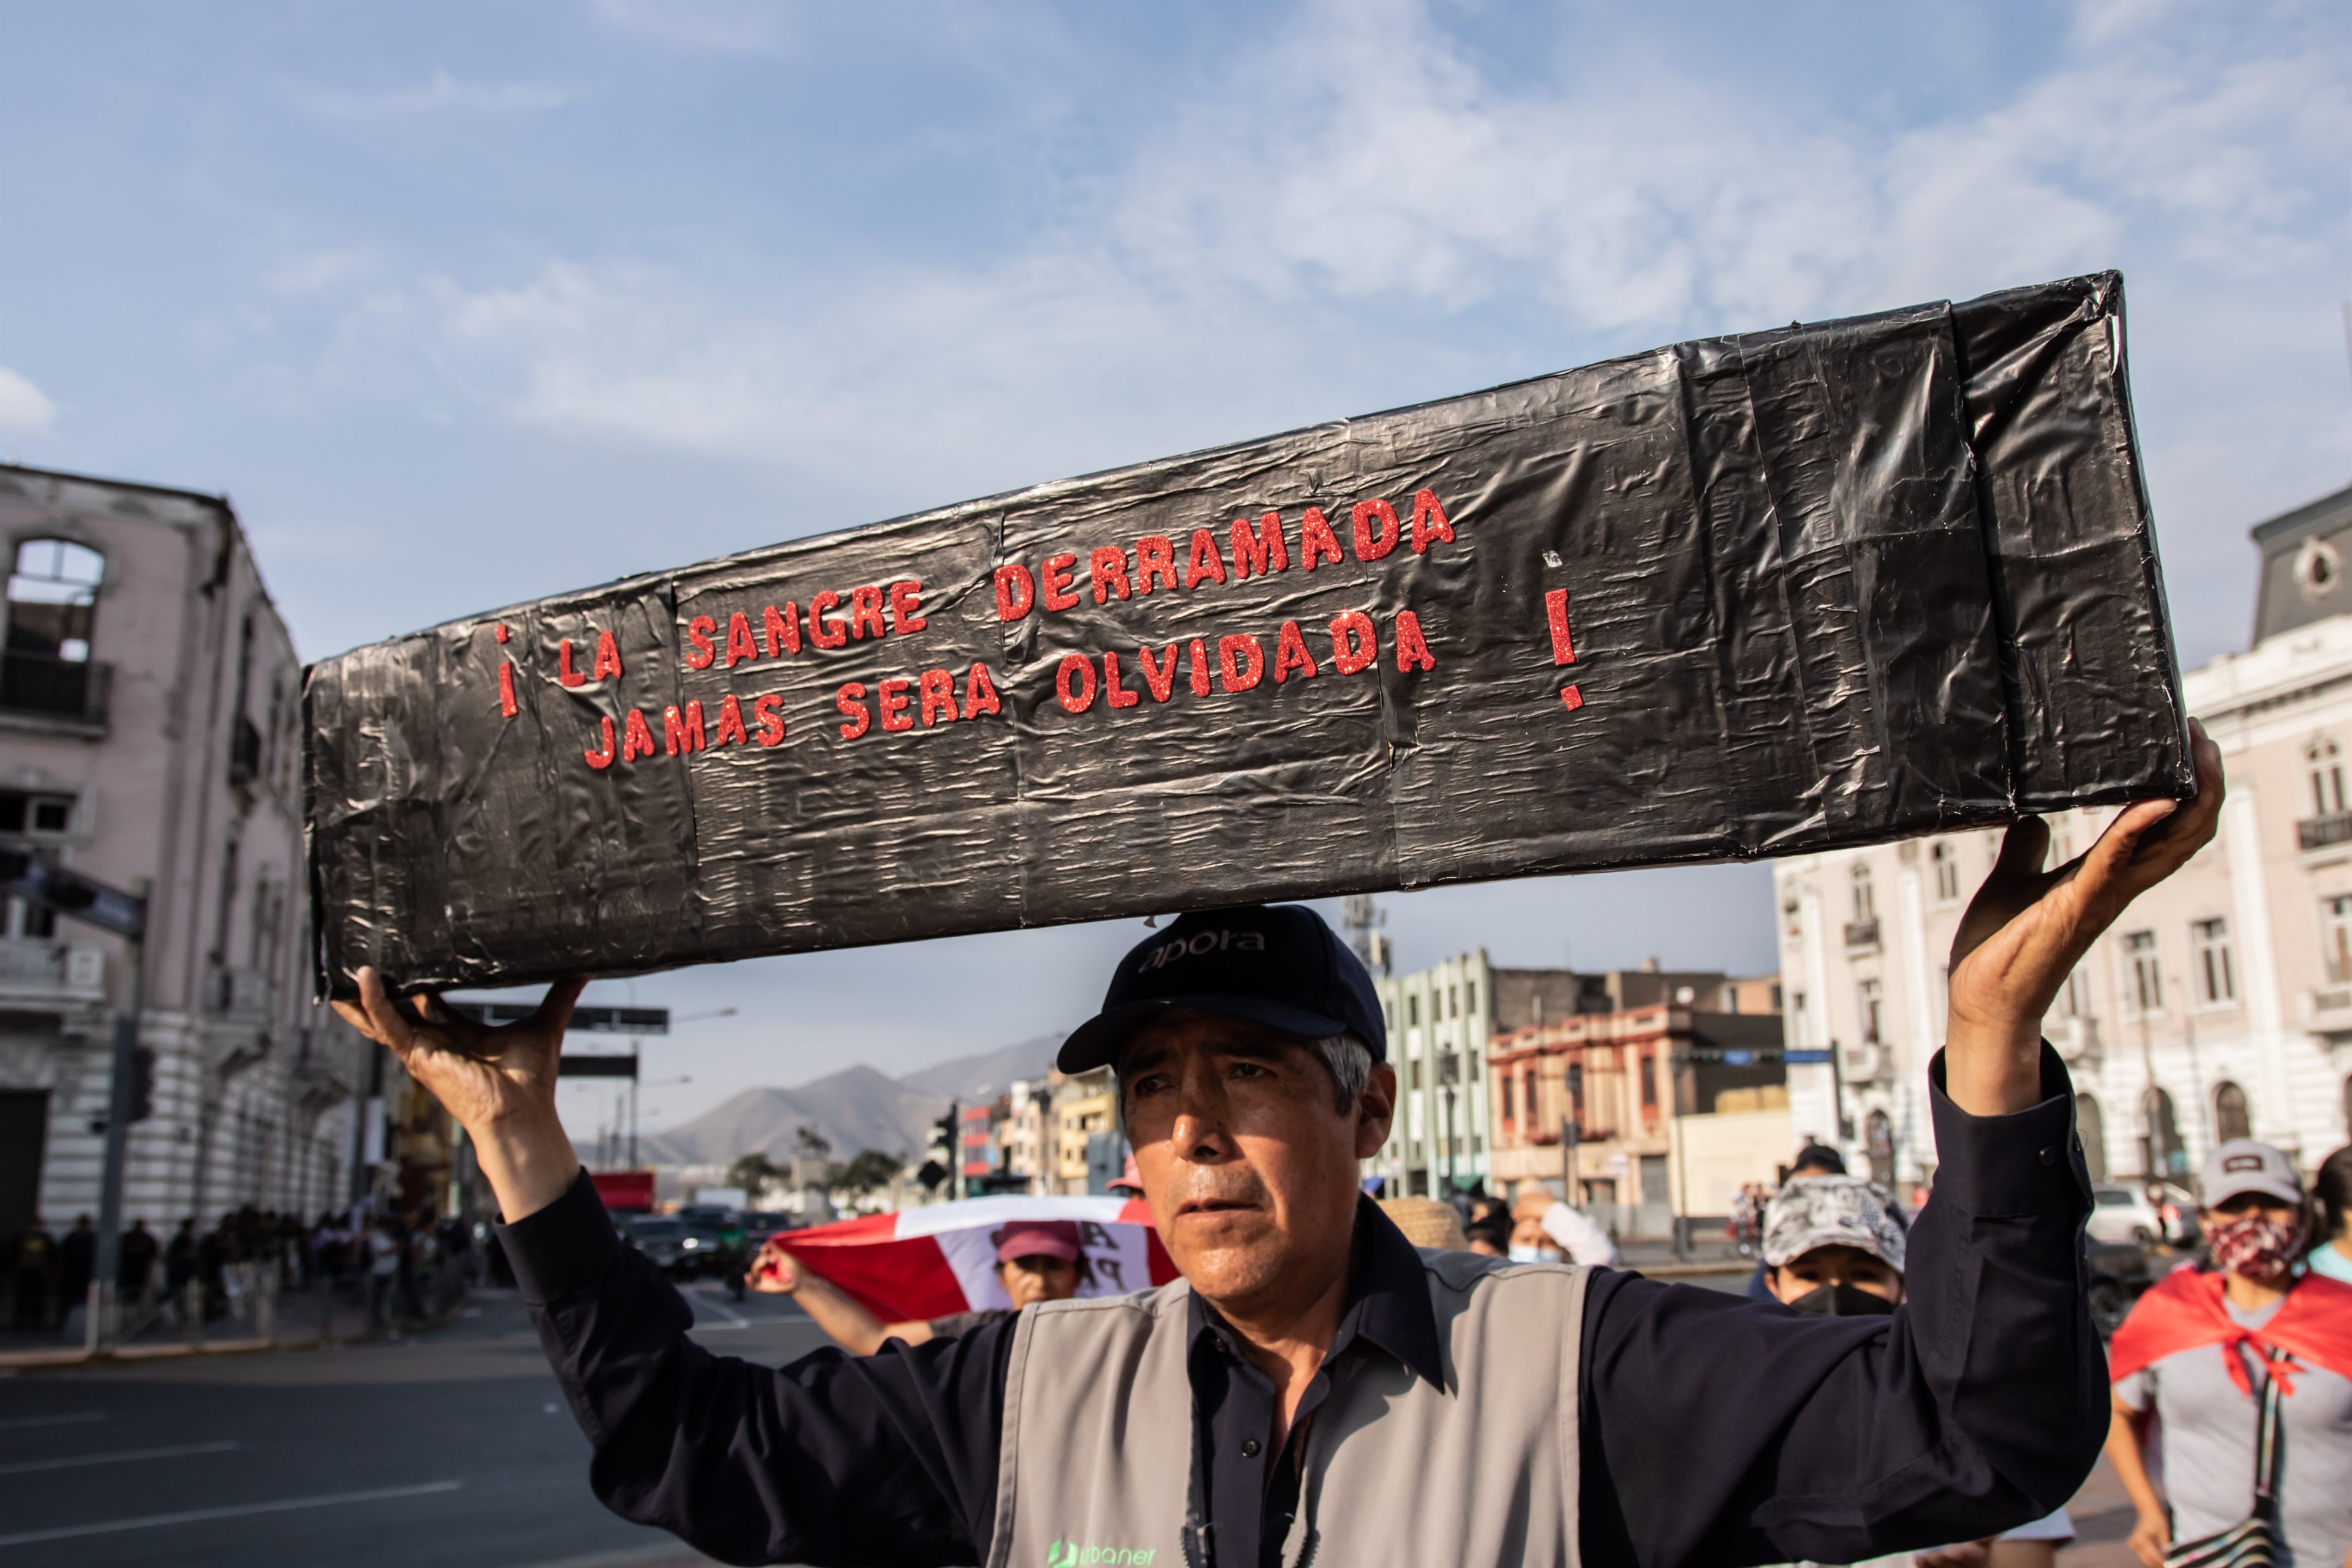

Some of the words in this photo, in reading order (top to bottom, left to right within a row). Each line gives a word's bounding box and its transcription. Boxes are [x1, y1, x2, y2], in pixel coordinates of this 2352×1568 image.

[559, 631, 622, 687] LA
[687, 580, 927, 670] SANGRE
[993, 489, 1456, 622] DERRAMADA
[583, 693, 786, 770] JAMAS
[835, 662, 1001, 741] SERA
[1055, 609, 1436, 714] OLVIDADA
